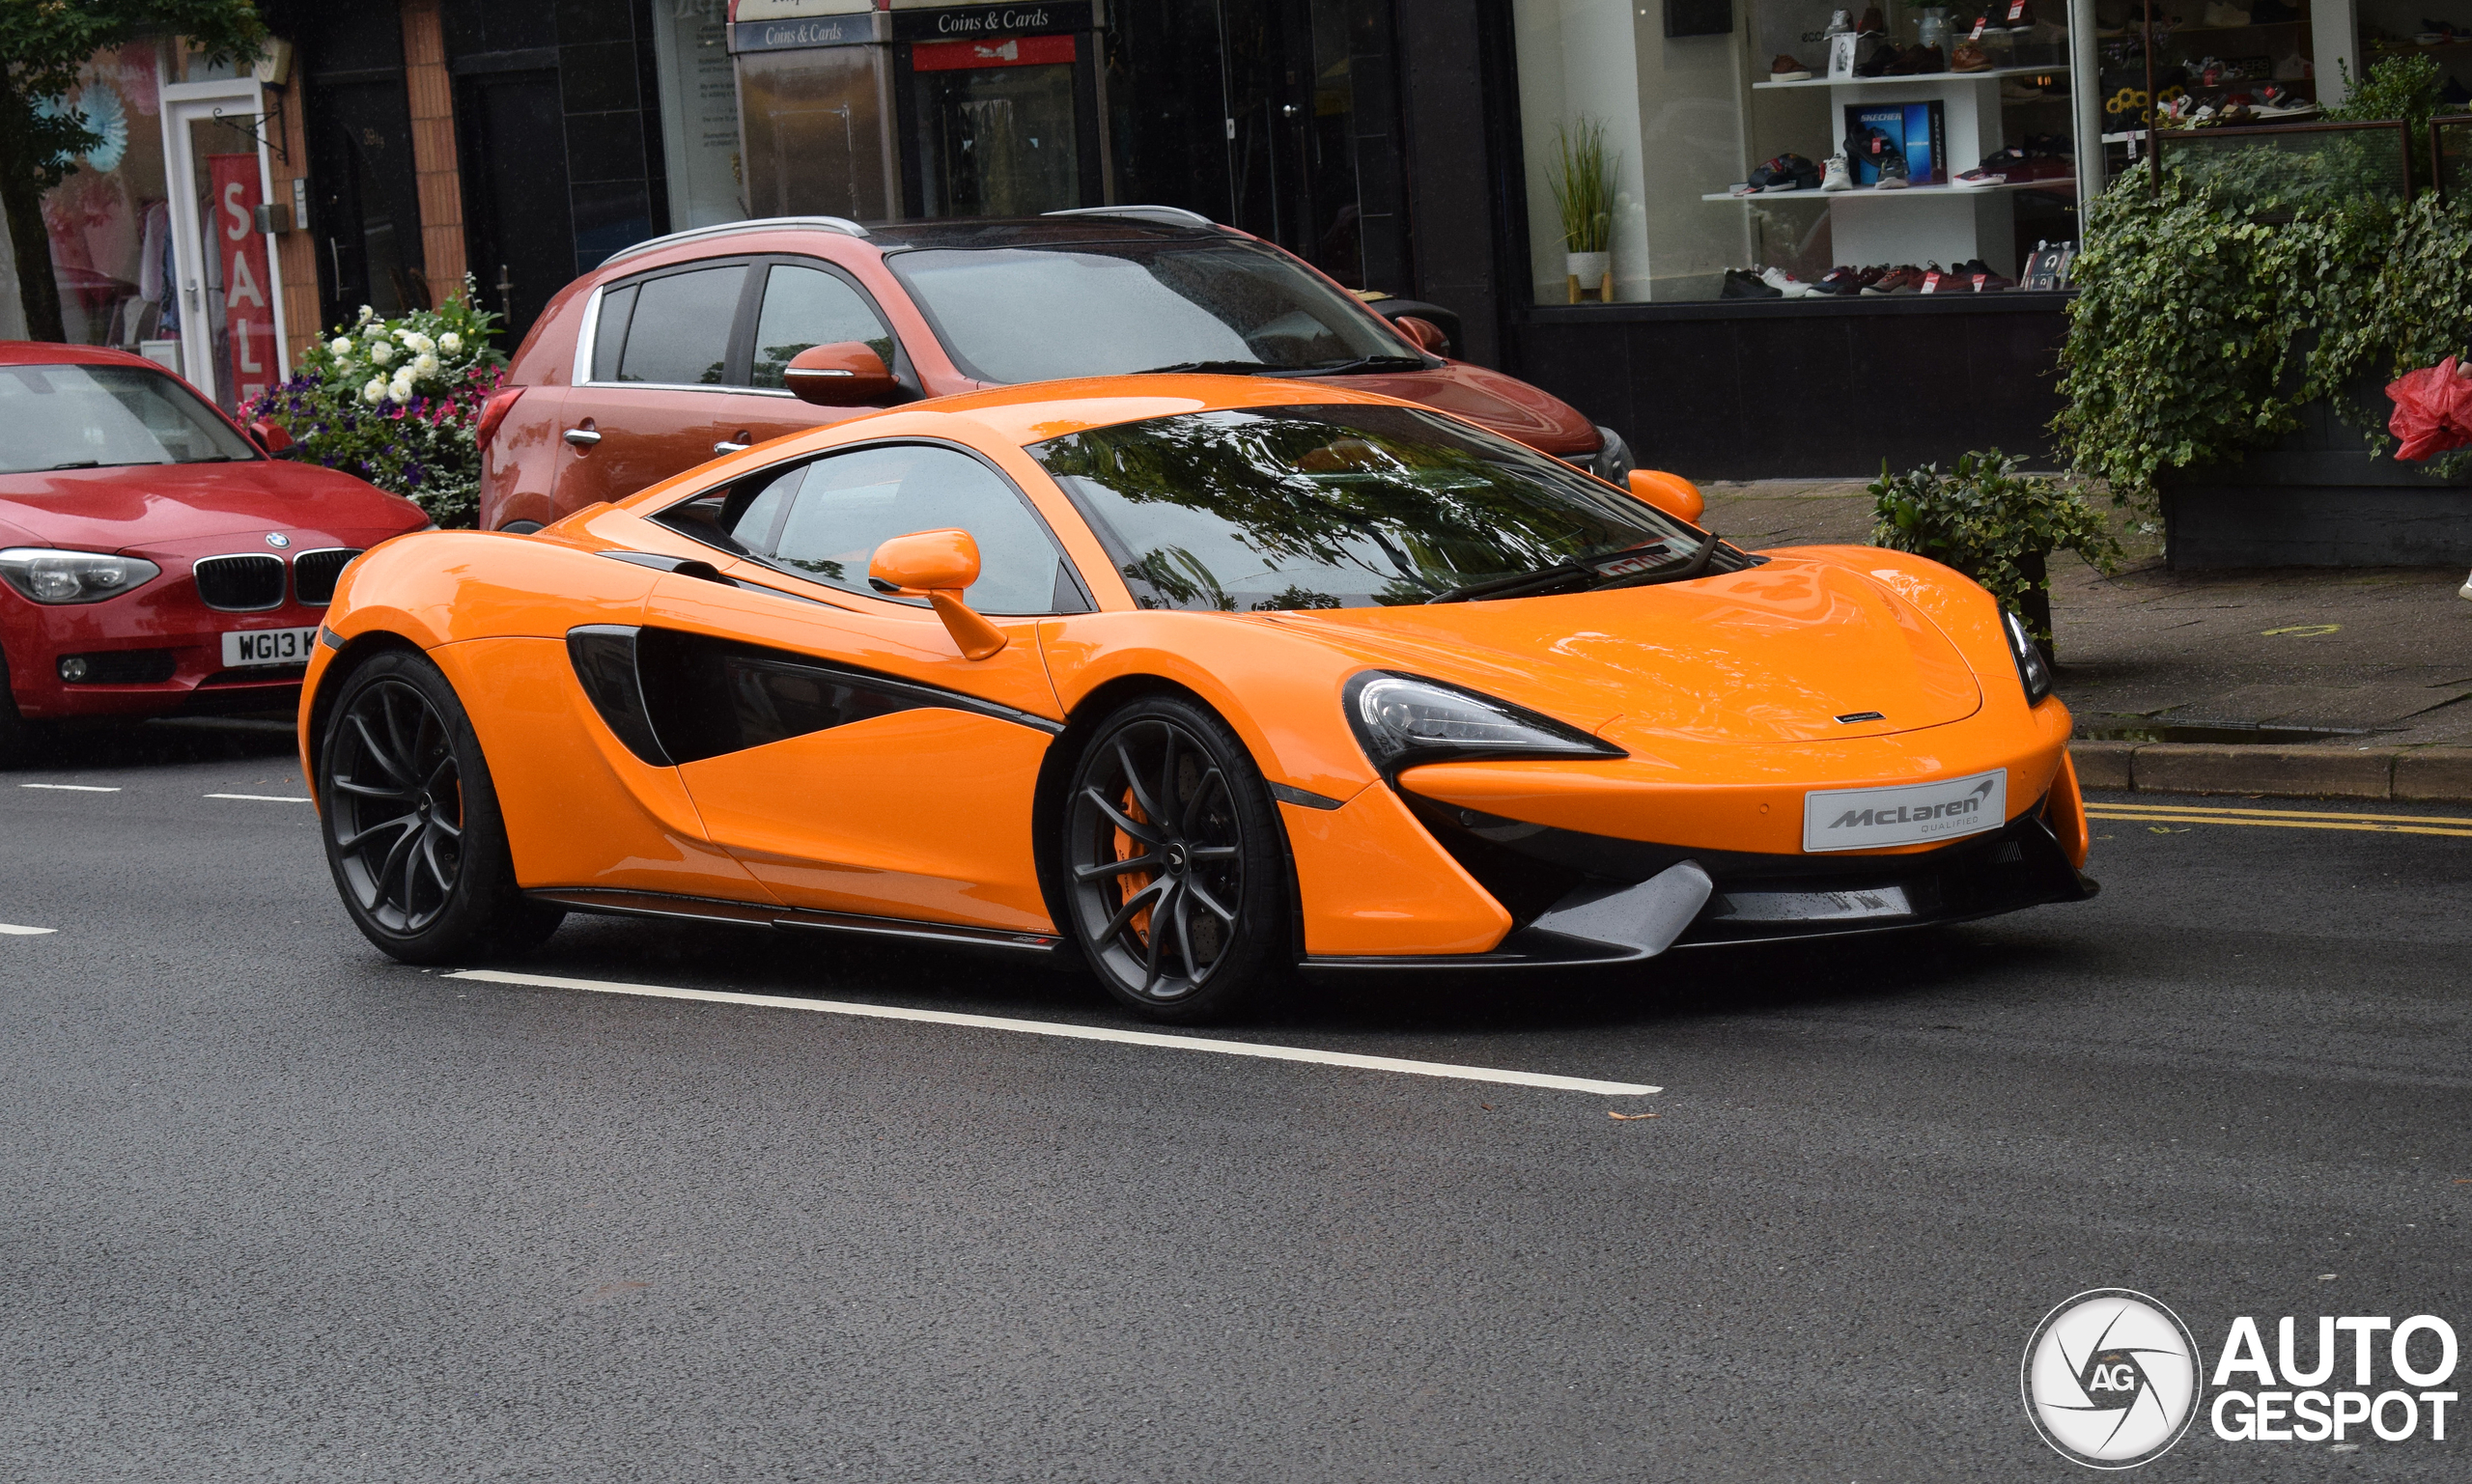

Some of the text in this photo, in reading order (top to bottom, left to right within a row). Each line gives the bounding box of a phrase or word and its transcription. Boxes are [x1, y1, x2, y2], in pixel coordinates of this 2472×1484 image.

[939, 9, 1049, 33] Coins & Cards
[766, 22, 842, 45] Coins & Cards
[1801, 31, 1825, 42] ecc
[239, 632, 295, 660] WG13
[1827, 797, 1979, 828] McLaren
[1921, 816, 1979, 833] QUALIFIED
